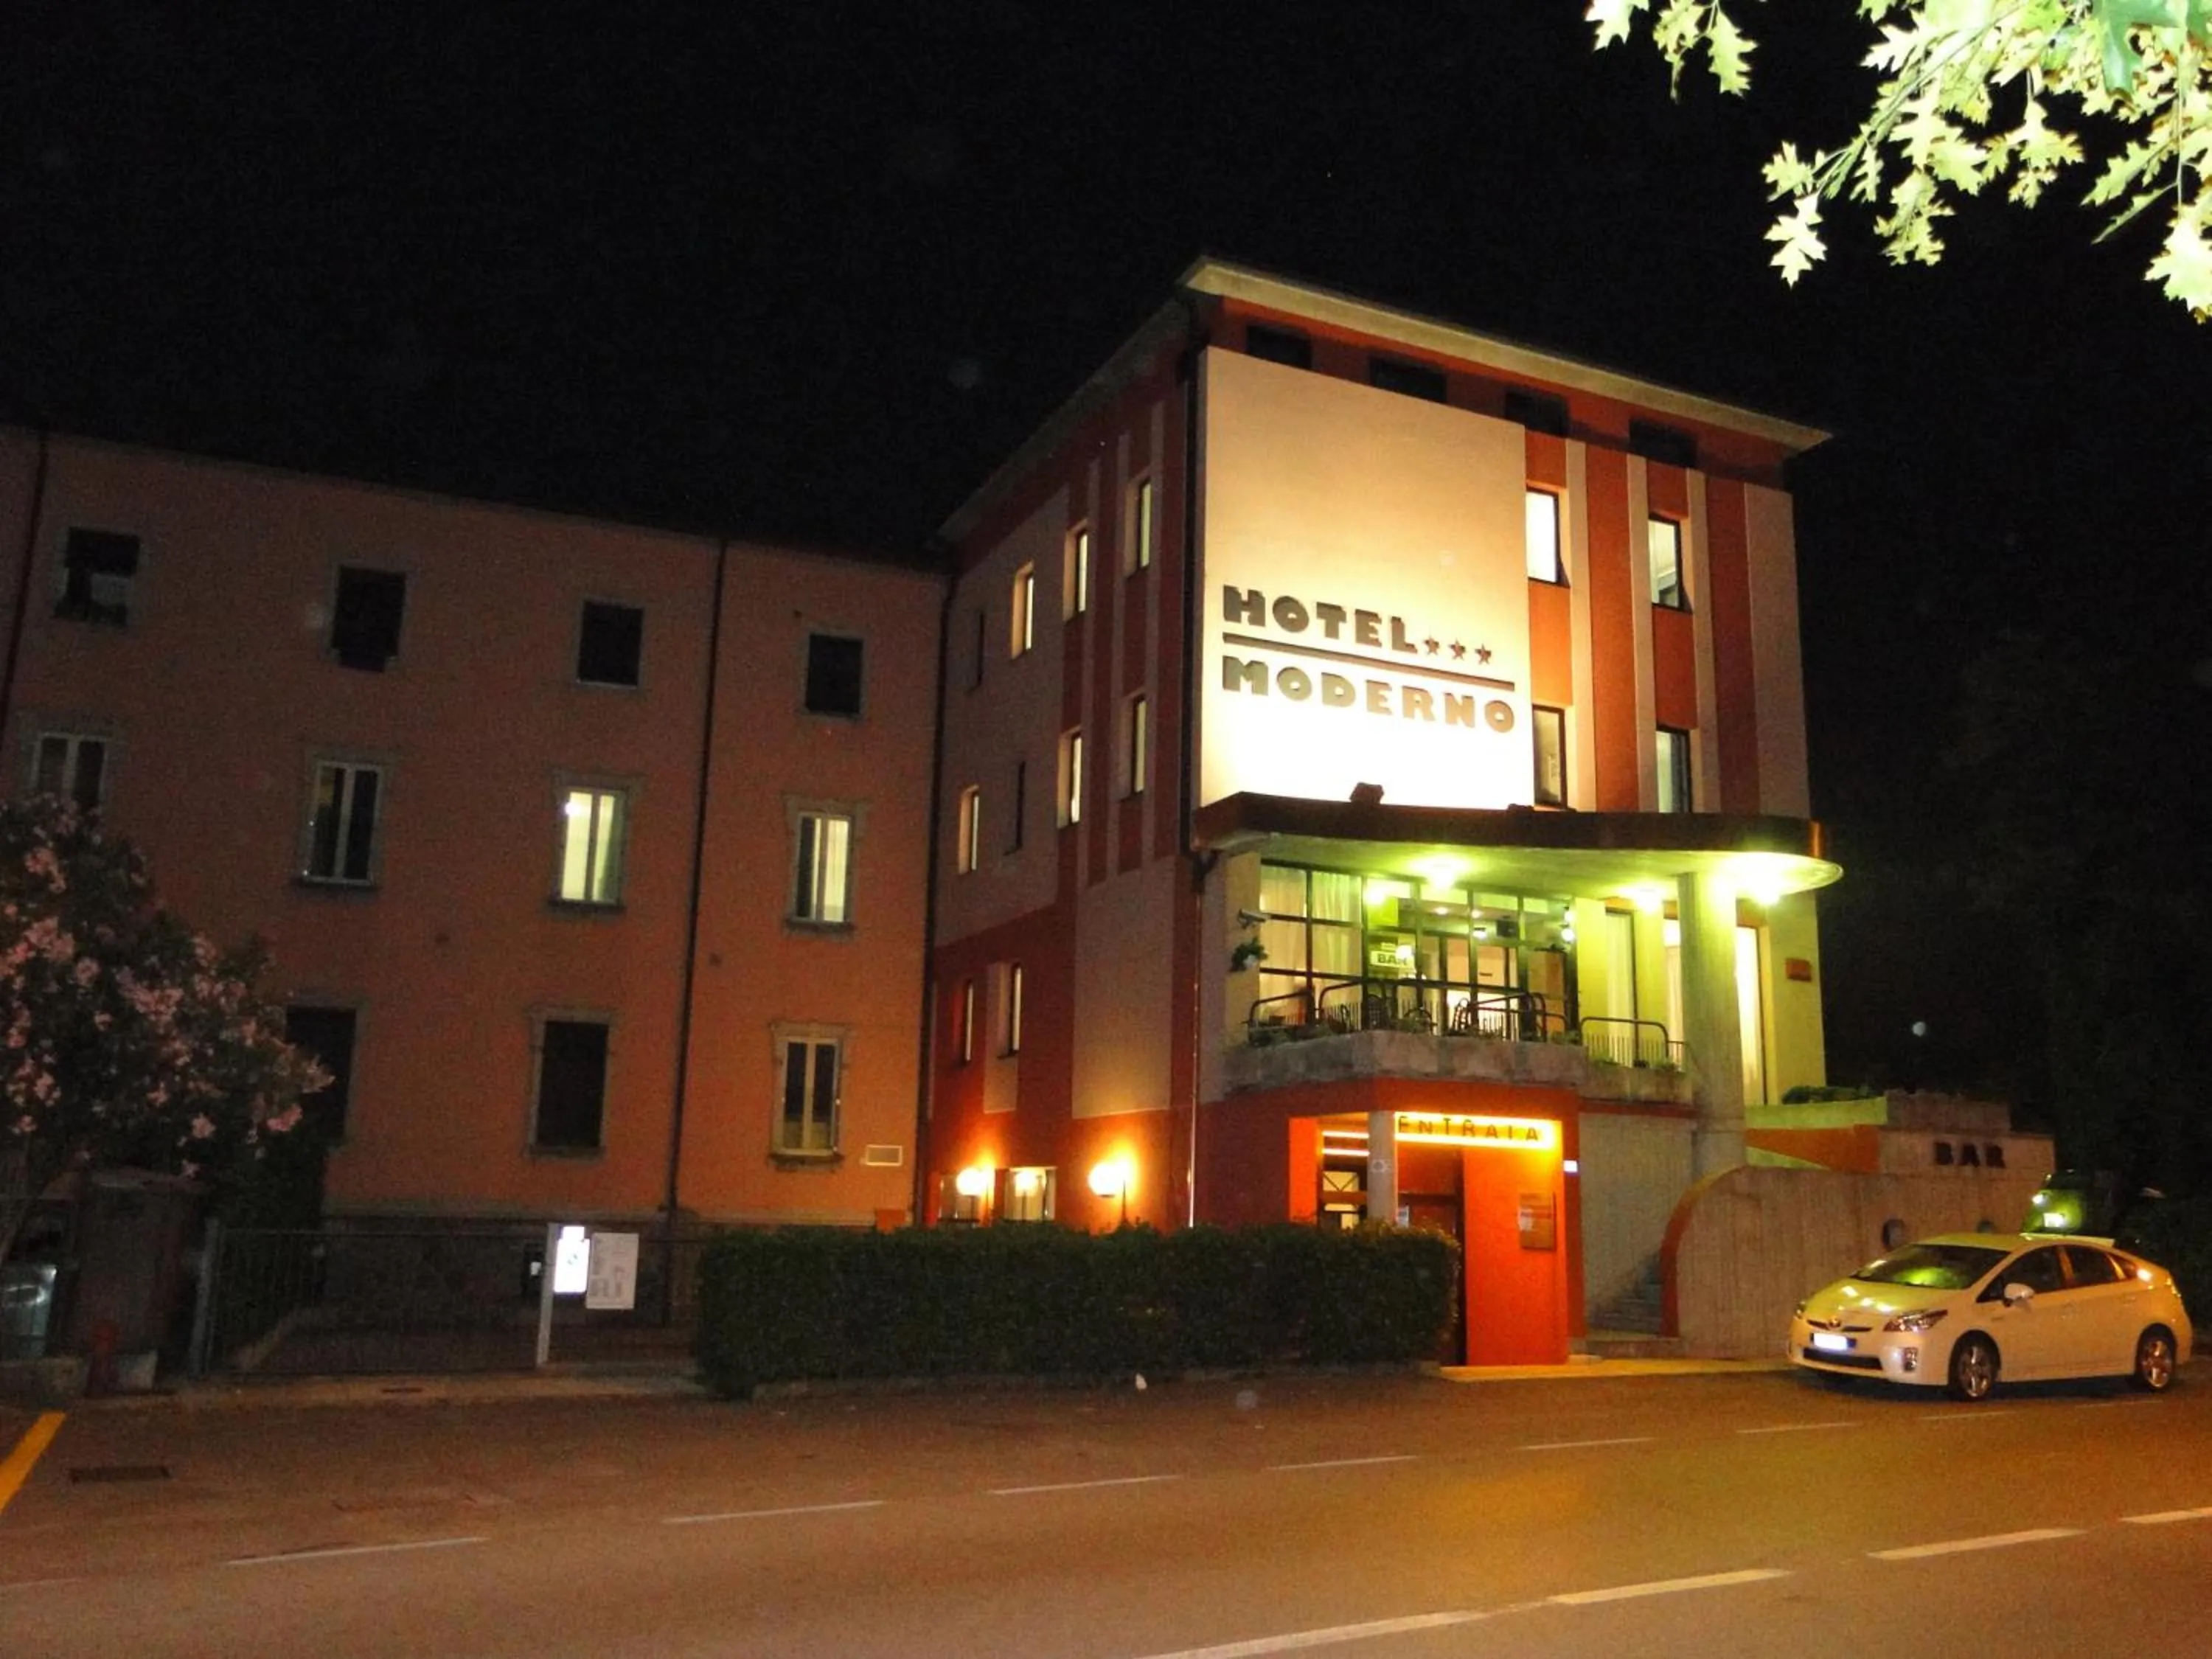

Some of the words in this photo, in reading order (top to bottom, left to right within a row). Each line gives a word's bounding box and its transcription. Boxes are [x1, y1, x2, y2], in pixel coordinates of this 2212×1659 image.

[1222, 584, 1418, 655] HOTEL
[1222, 655, 1515, 733] MODERNO
[1933, 1141, 2006, 1169] BAR
